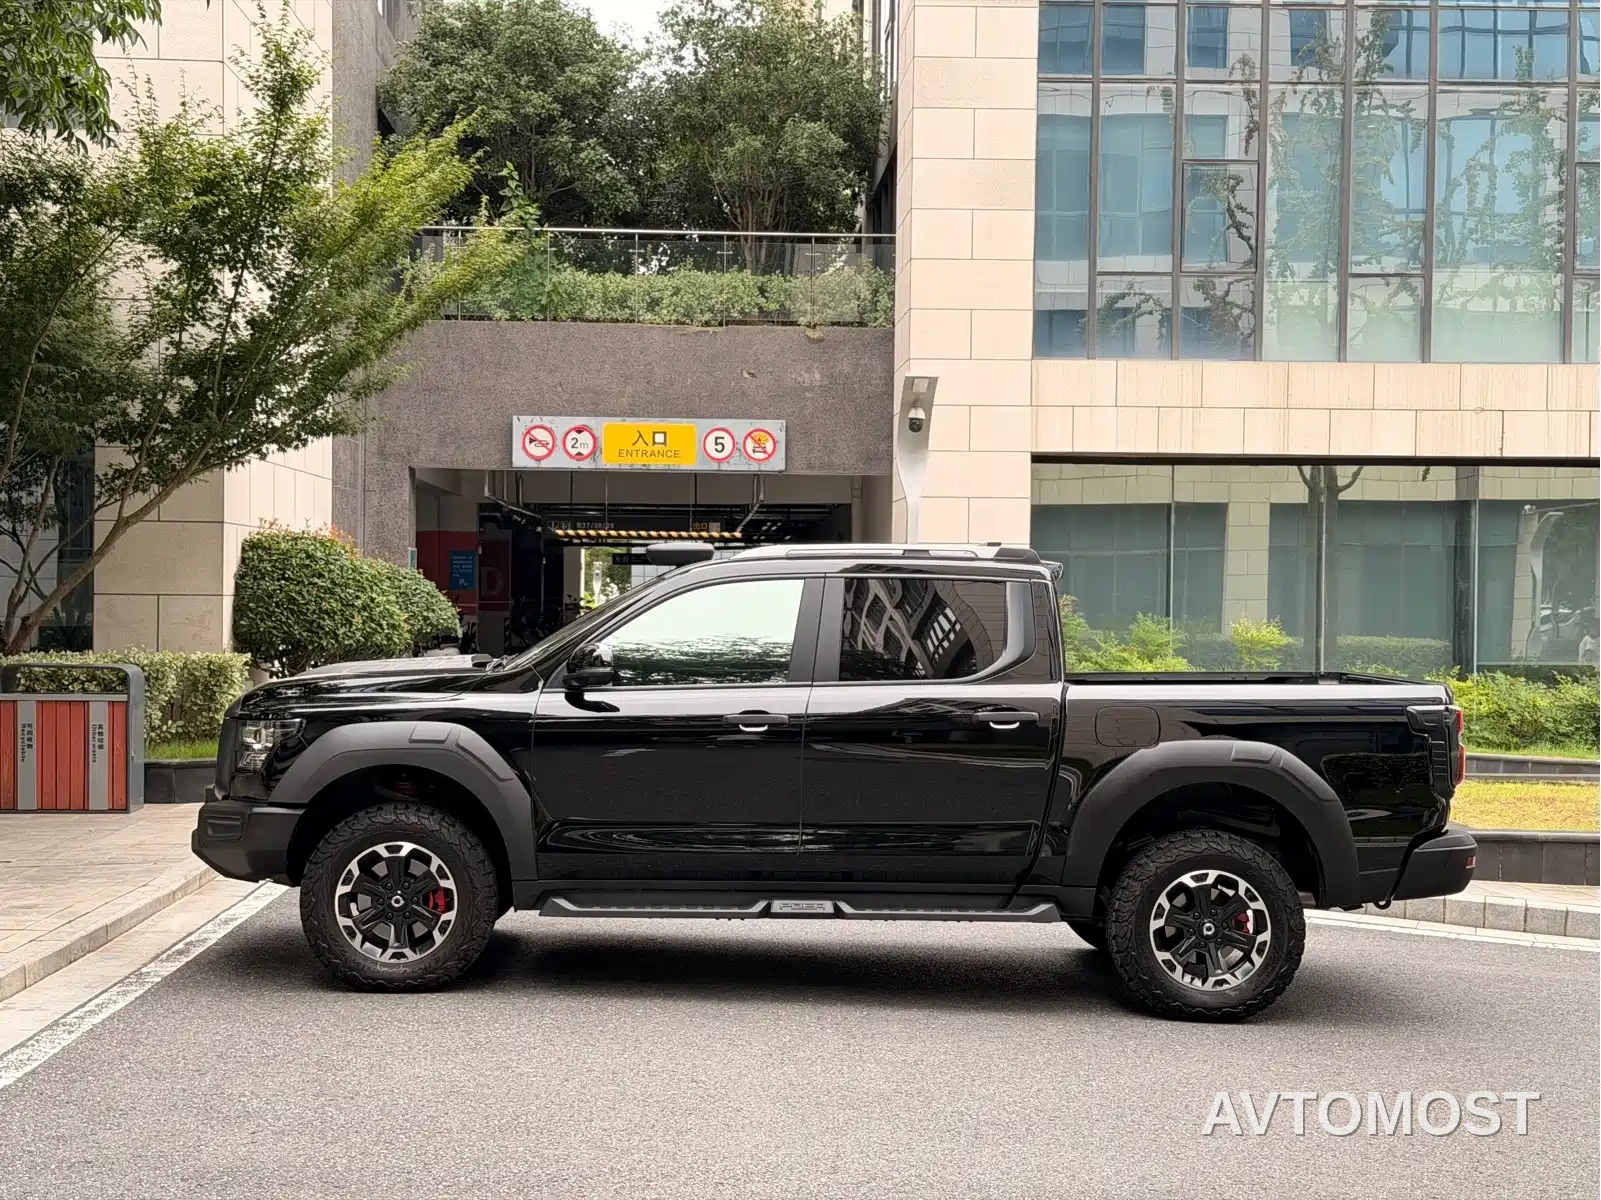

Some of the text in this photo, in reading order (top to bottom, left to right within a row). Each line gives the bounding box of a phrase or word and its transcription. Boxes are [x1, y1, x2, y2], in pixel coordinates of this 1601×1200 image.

[570, 437, 589, 450] 2m
[632, 429, 667, 447] 入口
[714, 436, 725, 453] 5
[618, 448, 681, 459] ENTRANCE
